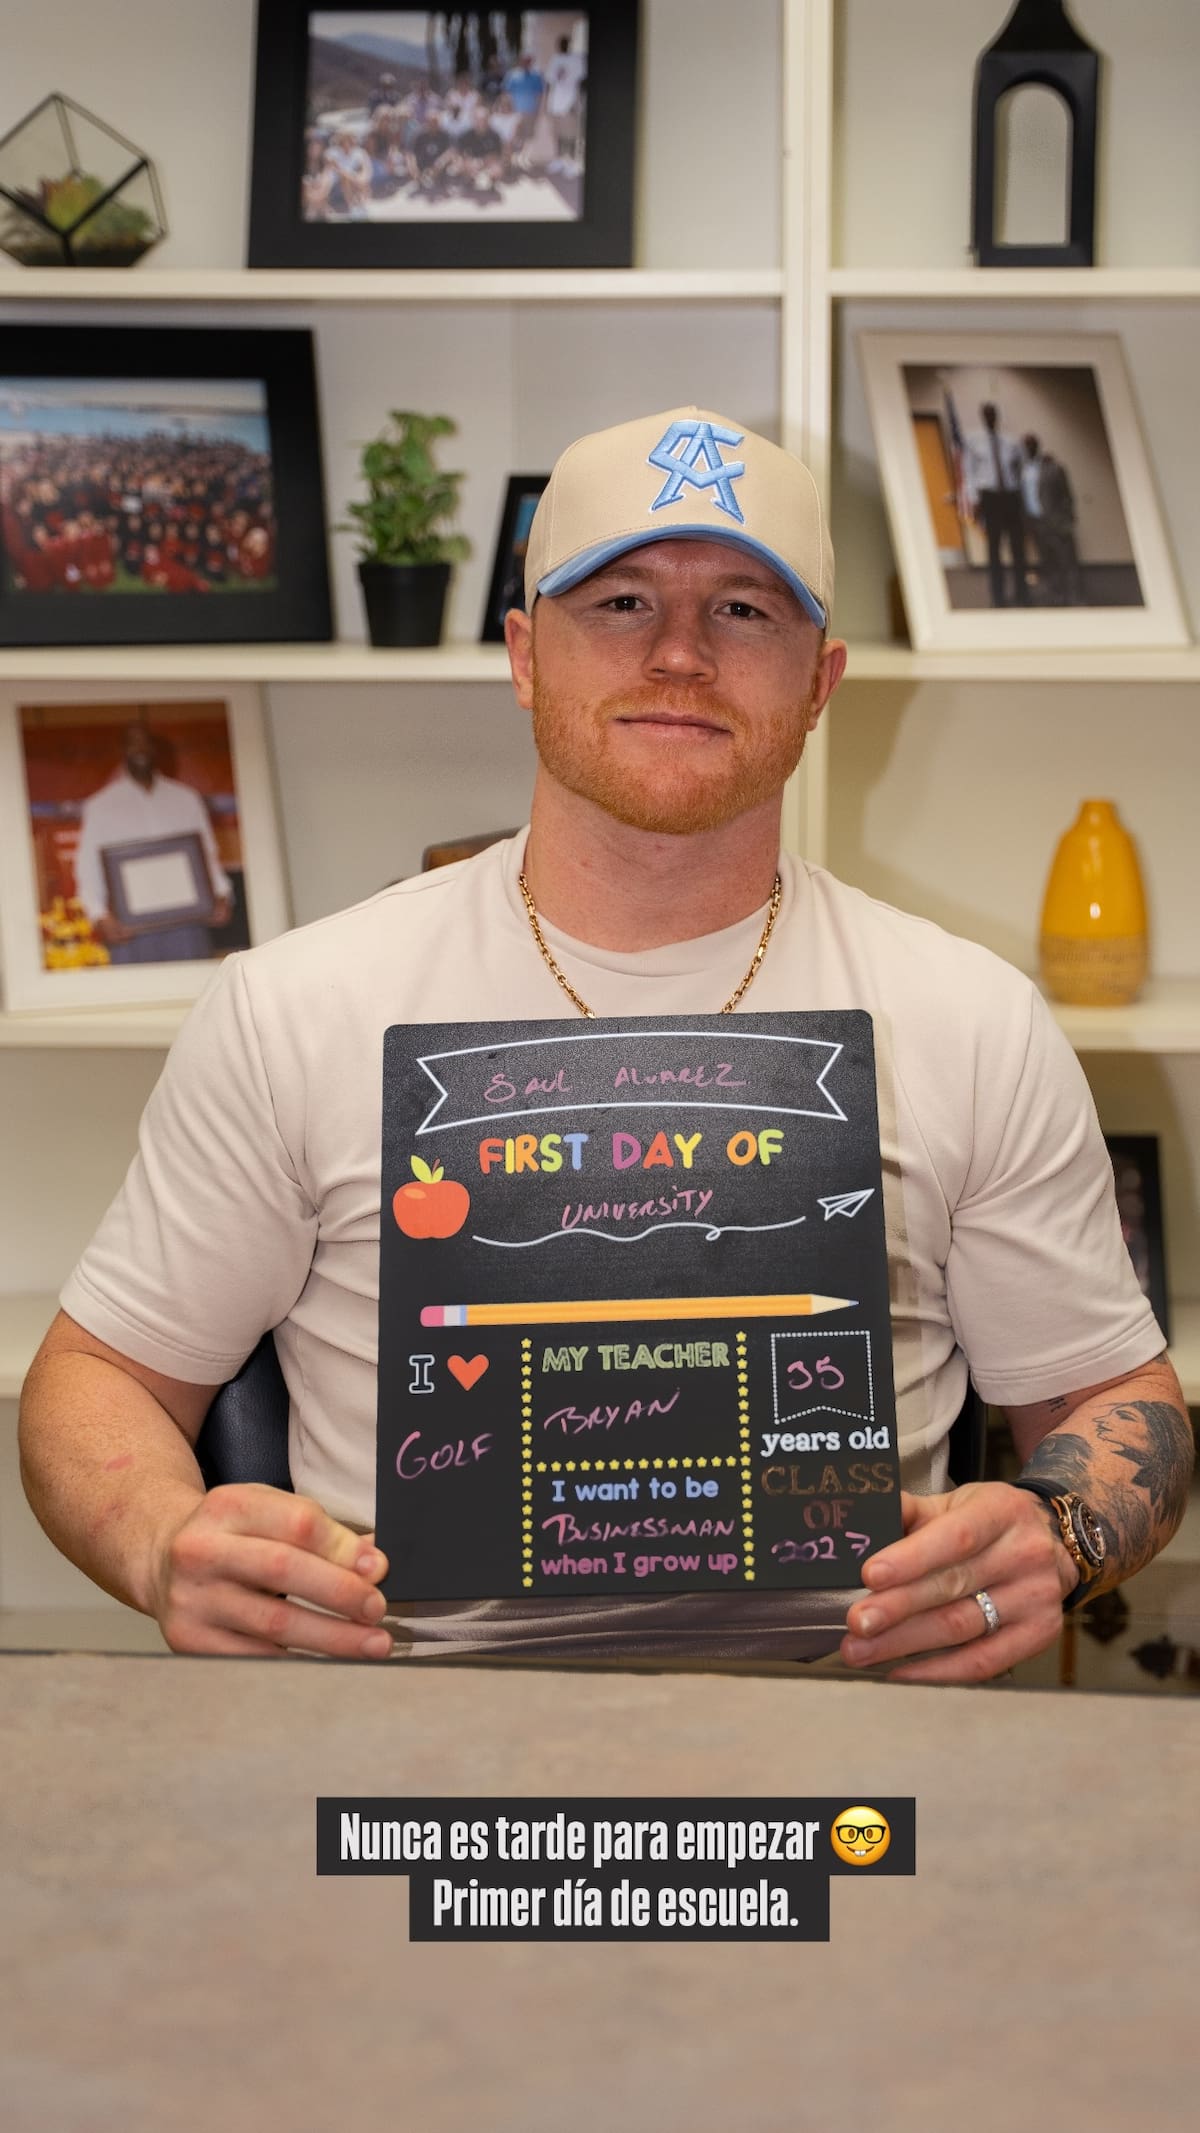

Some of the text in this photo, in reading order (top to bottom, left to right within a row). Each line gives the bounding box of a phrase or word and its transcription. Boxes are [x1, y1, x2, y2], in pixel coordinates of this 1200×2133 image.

[479, 1129, 785, 1174] FIRST DAY OF
[542, 1342, 730, 1372] MY TEACHER
[787, 1356, 845, 1390] 35
[409, 1354, 435, 1394] I
[543, 1391, 680, 1435] BRYAN
[396, 1431, 493, 1479] GOLF
[760, 1426, 890, 1457] years old
[552, 1476, 719, 1502] I want to be
[761, 1463, 895, 1495] CLASS
[803, 1500, 853, 1529] OF
[541, 1552, 738, 1577] when I grow up
